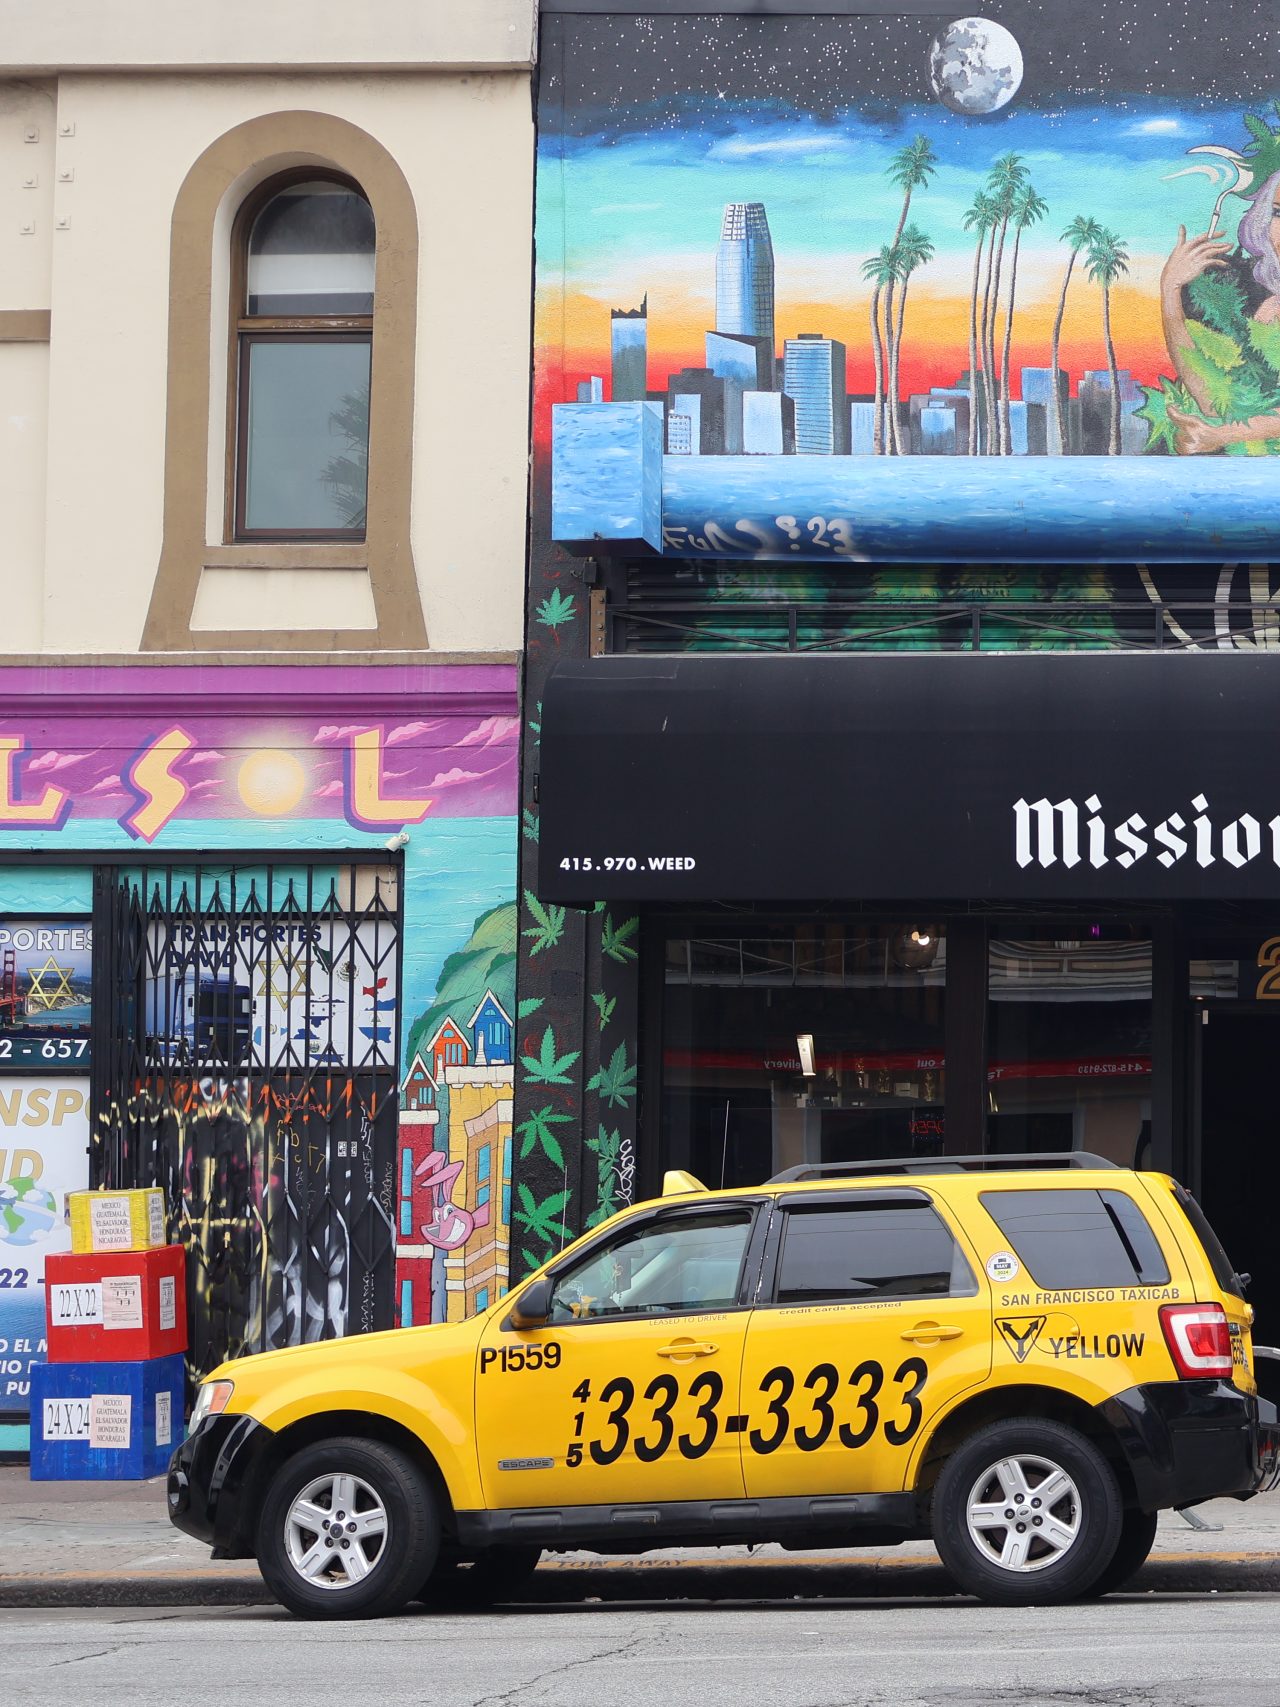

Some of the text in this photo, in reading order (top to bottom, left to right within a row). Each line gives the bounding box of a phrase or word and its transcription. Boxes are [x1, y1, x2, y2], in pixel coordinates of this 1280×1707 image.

[559, 857, 696, 871] 415.970.WEED
[42, 1040, 92, 1059] 657
[0, 1088, 91, 1127] NSP
[60, 1289, 71, 1317] 22
[74, 1289, 83, 1317] X
[86, 1288, 96, 1316] 22
[849, 1302, 902, 1312] accepted
[1001, 1288, 1180, 1307] SAN FRANCISCO TAXICAB
[649, 1314, 728, 1327] LEASED TO DRIVER
[14, 1339, 32, 1353] EL
[1049, 1333, 1145, 1359] YELLOW
[0, 1360, 22, 1374] IO
[480, 1342, 561, 1374] P1559
[47, 1403, 89, 1434] 24 X 24
[589, 1357, 928, 1467] 333-3333
[501, 1459, 551, 1469] ESCAPE
